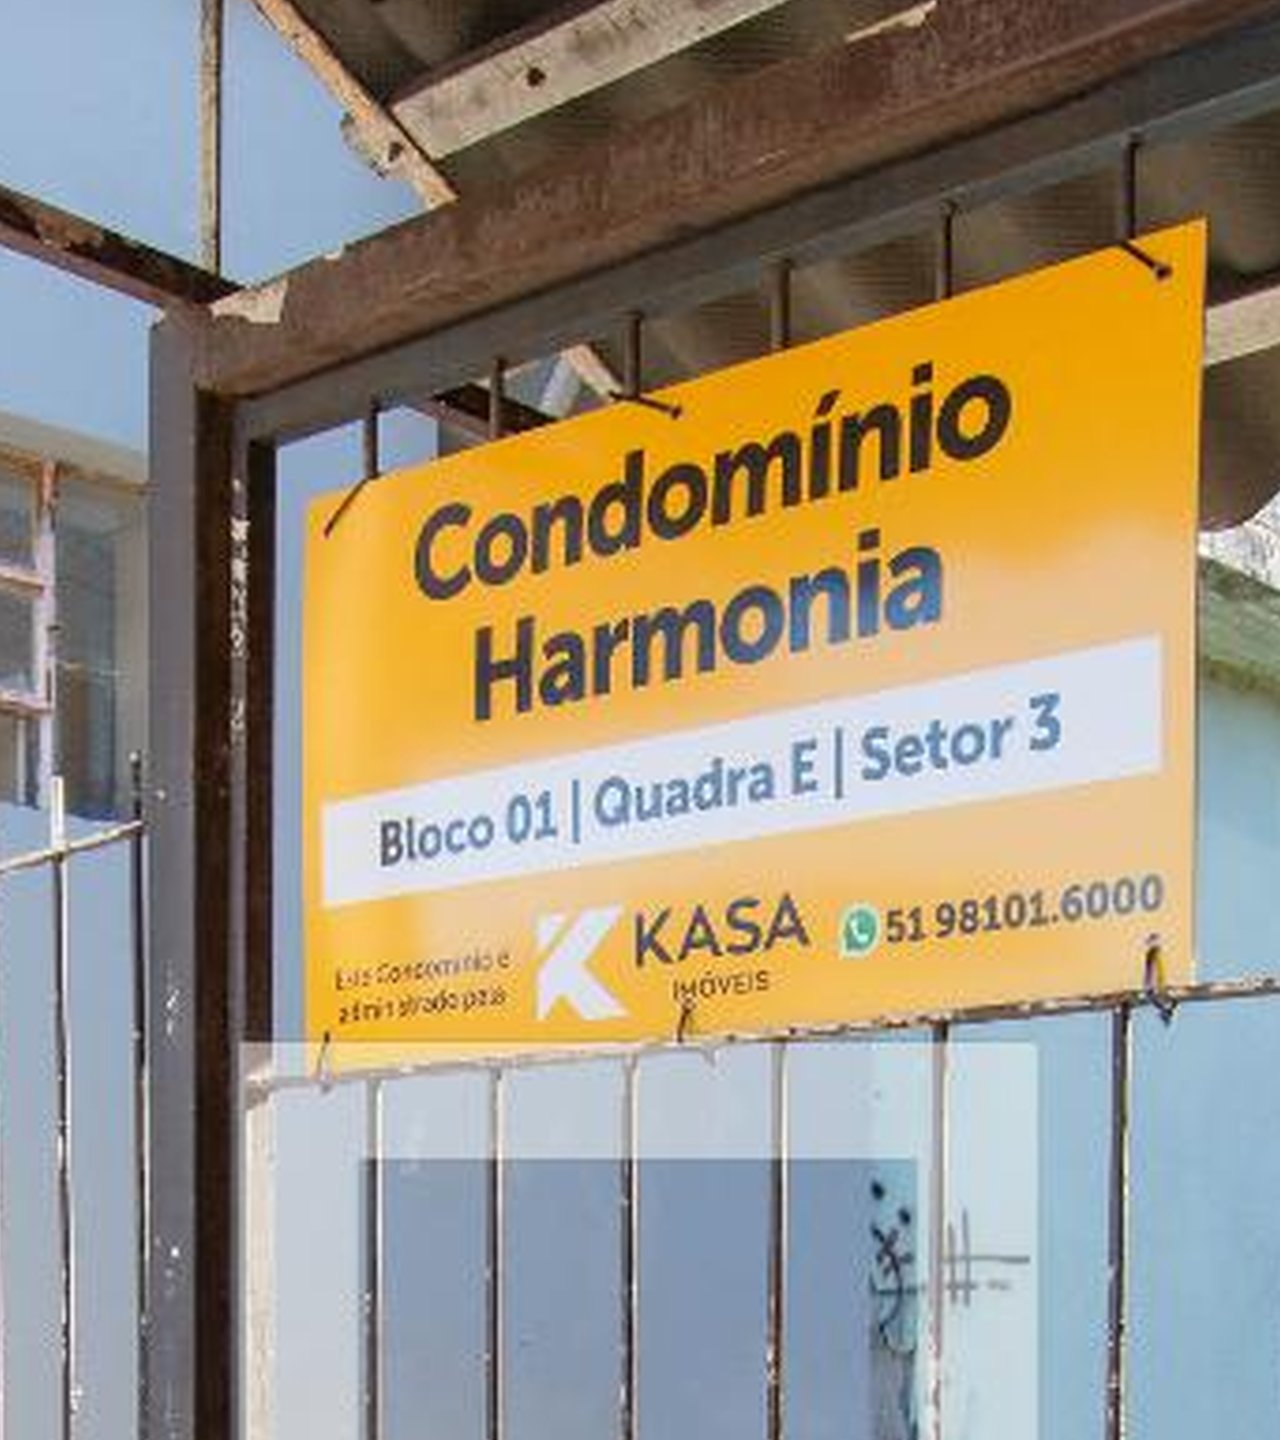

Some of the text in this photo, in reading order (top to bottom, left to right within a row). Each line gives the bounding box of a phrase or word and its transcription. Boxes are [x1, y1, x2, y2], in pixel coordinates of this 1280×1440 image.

[414, 361, 1012, 600] Condomínio
[474, 528, 942, 720] Harmonia
[380, 815, 495, 867] Bloco
[506, 790, 558, 844] 01
[593, 757, 776, 827] Quadra
[791, 738, 818, 795] E
[861, 715, 1015, 782] Setor
[1028, 693, 1061, 752] 3
[635, 893, 810, 967] KASA
[886, 873, 1164, 943] 51 98101.6000
